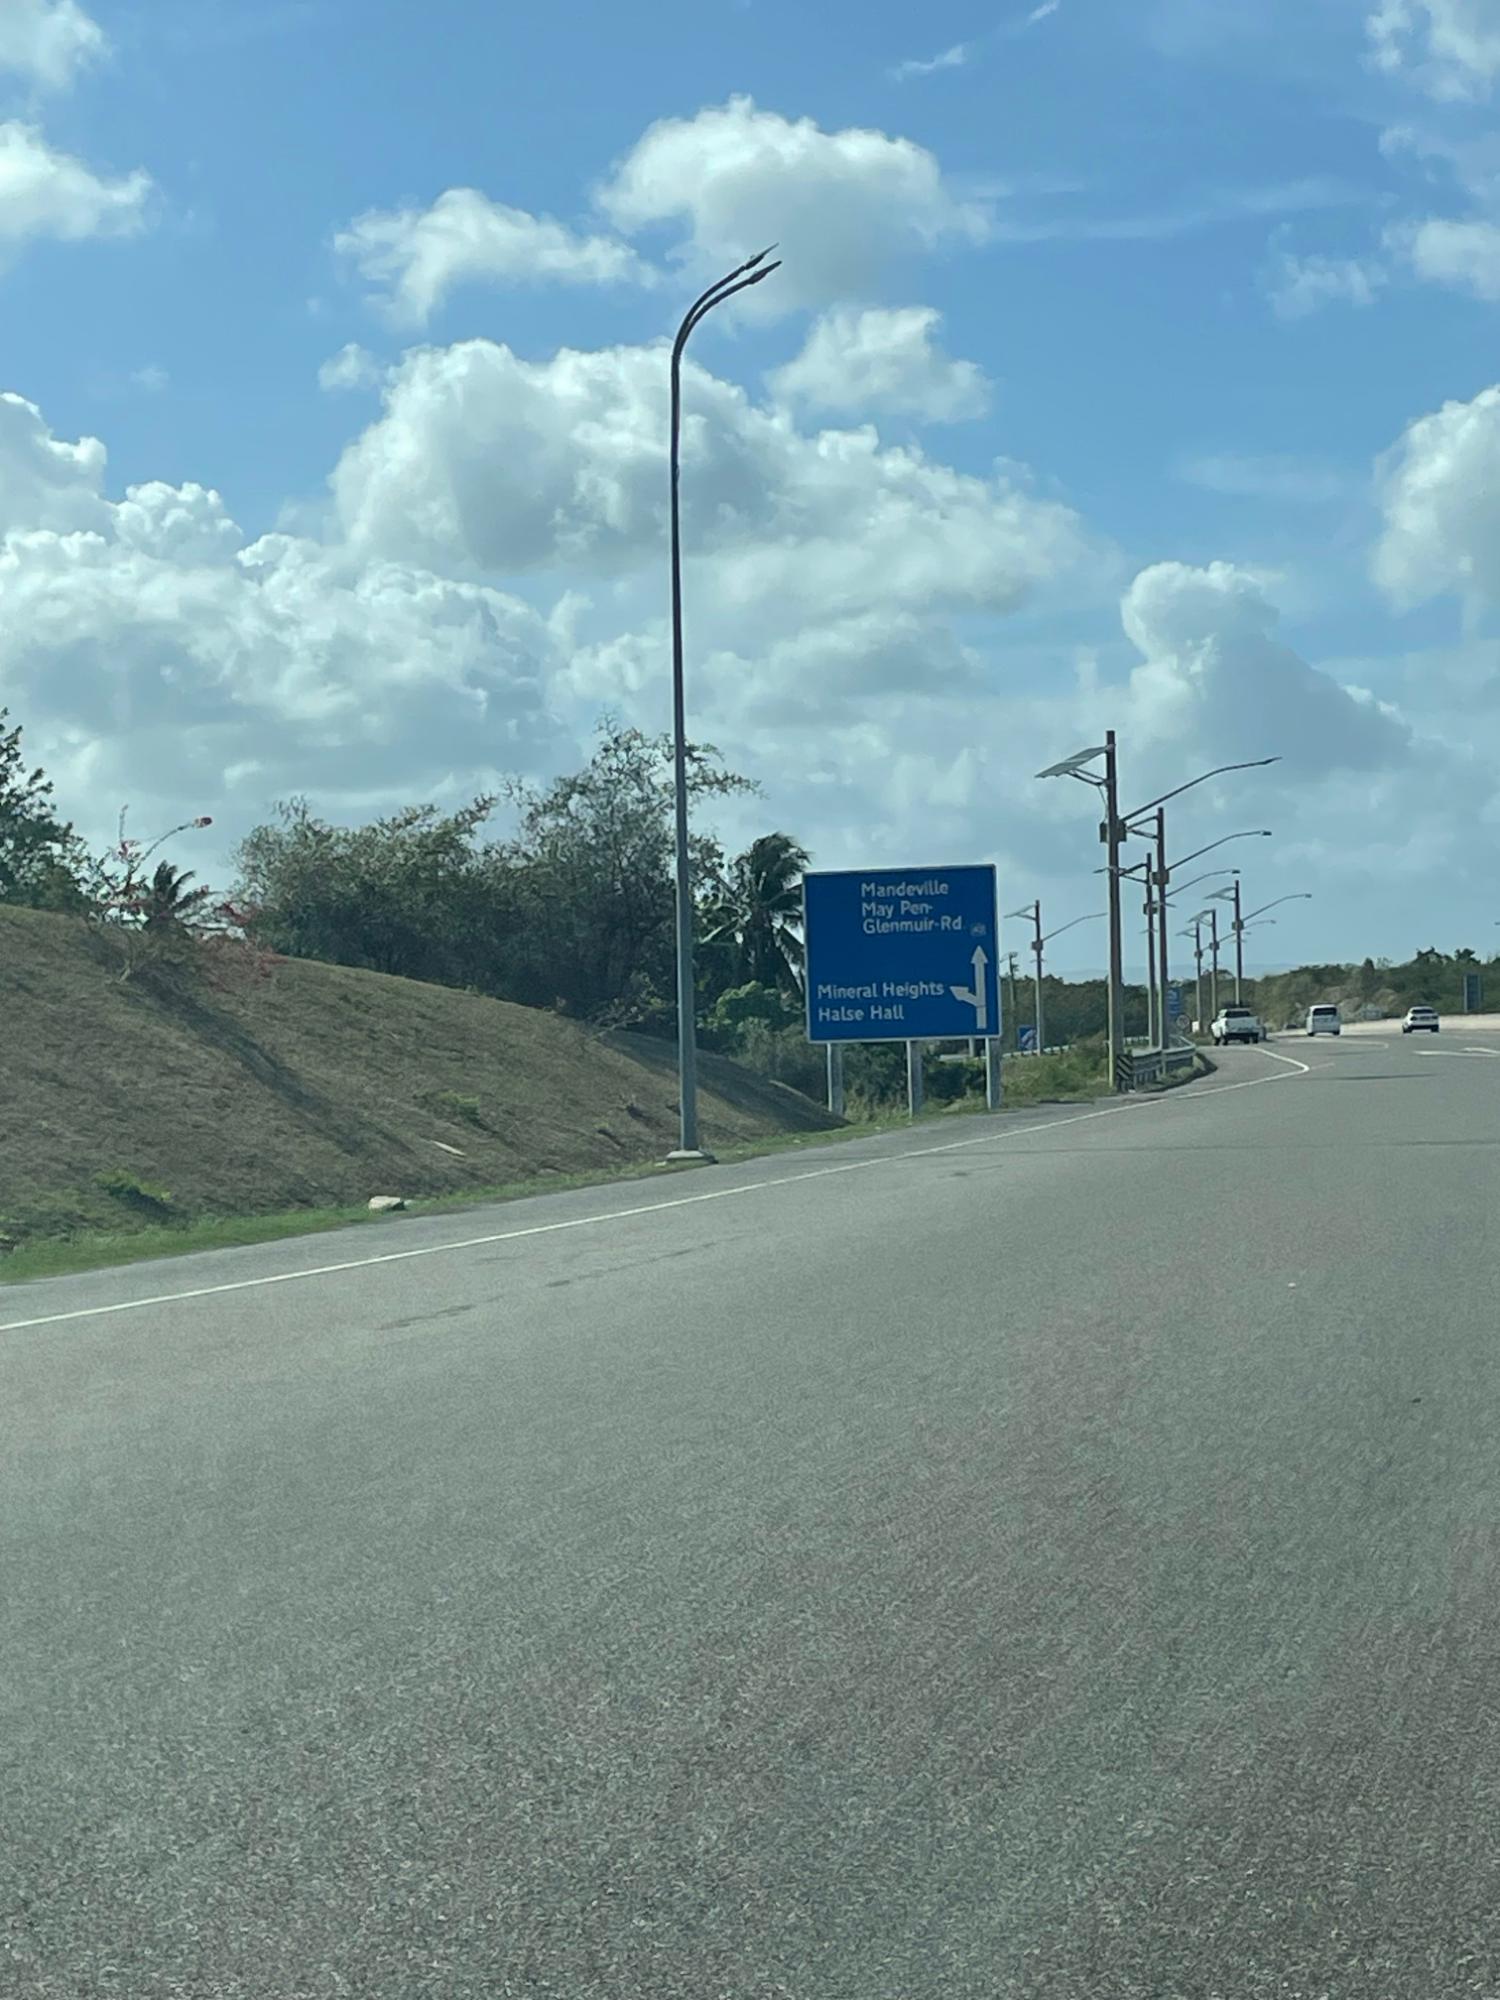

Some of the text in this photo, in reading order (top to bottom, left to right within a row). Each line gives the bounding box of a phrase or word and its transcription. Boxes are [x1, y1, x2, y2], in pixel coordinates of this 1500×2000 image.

[861, 880, 949, 897] Mandeville
[862, 902, 894, 919] May
[817, 981, 945, 1000] Mineral Heights
[818, 1005, 904, 1022] Halse Hall
